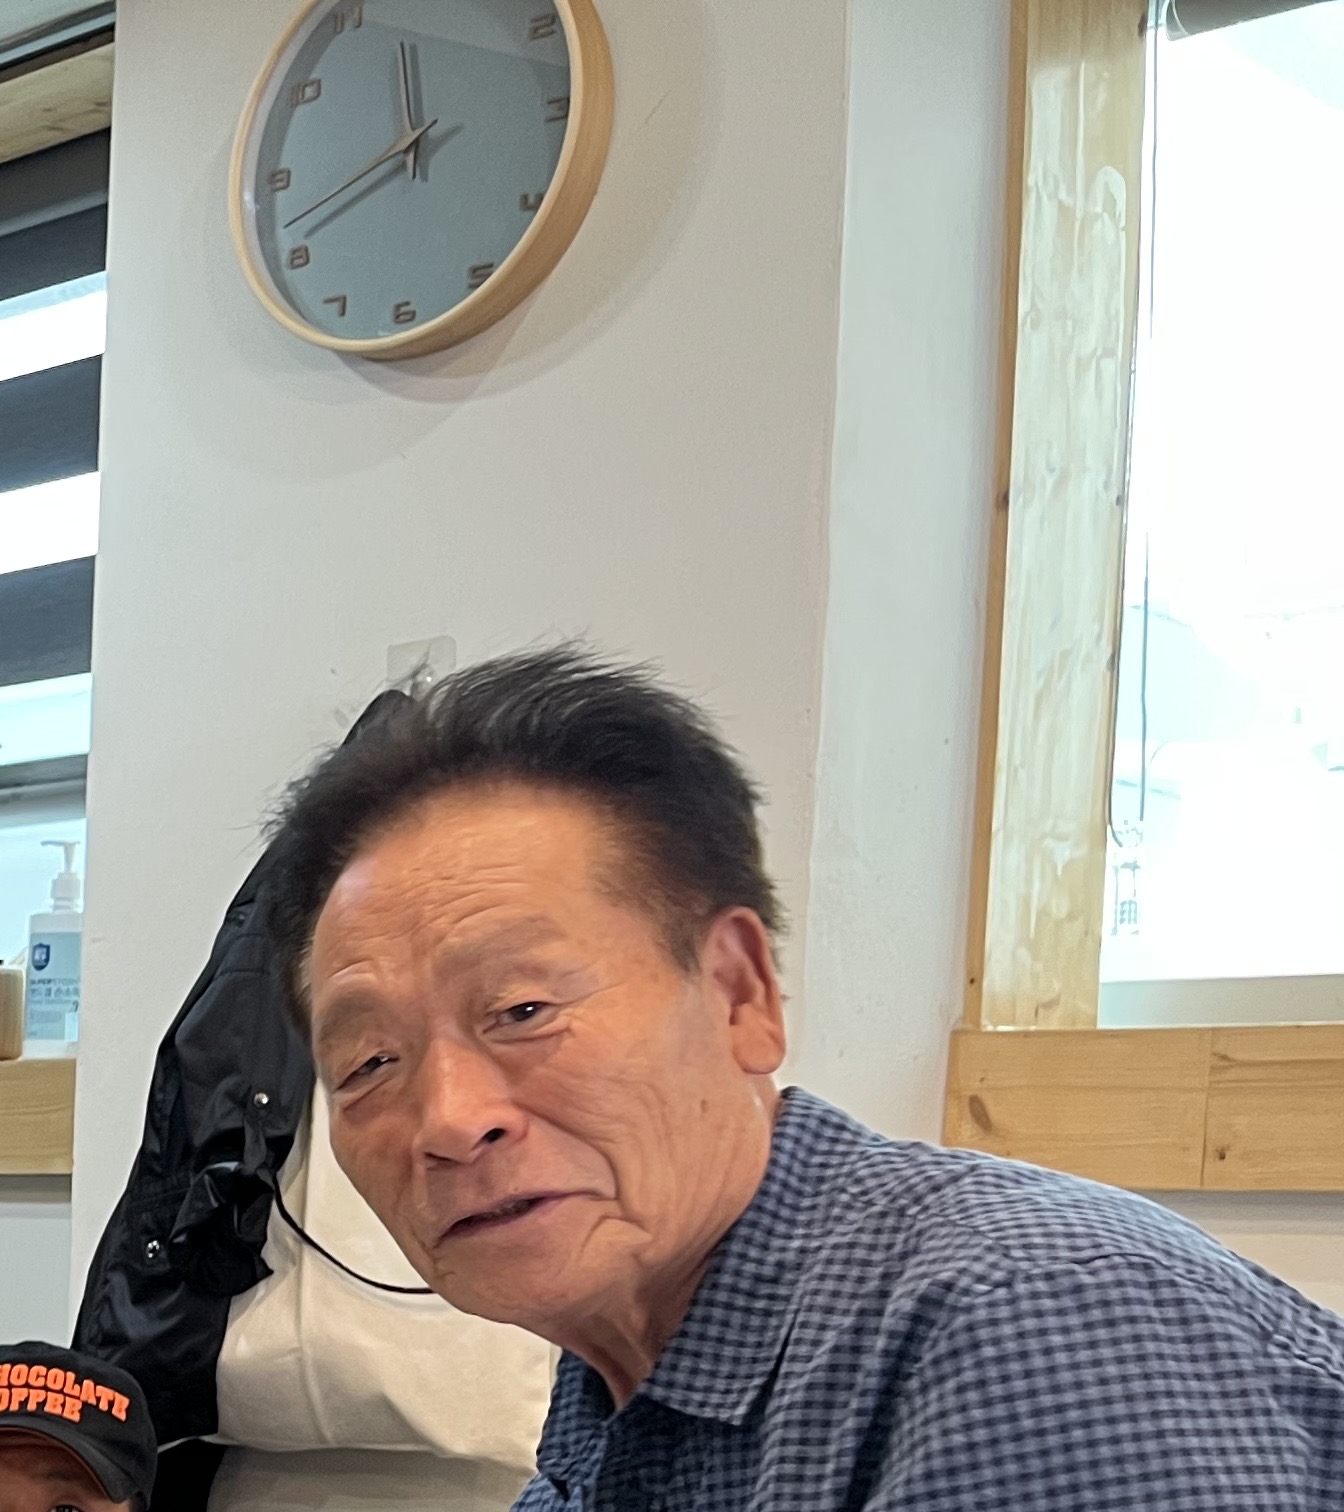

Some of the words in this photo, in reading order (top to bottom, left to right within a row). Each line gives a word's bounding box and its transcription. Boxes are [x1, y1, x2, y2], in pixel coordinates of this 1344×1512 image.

[290, 78, 321, 108] 10
[268, 168, 291, 192] 9
[289, 245, 310, 270] 8
[323, 295, 347, 317] 7
[394, 301, 416, 324] 6
